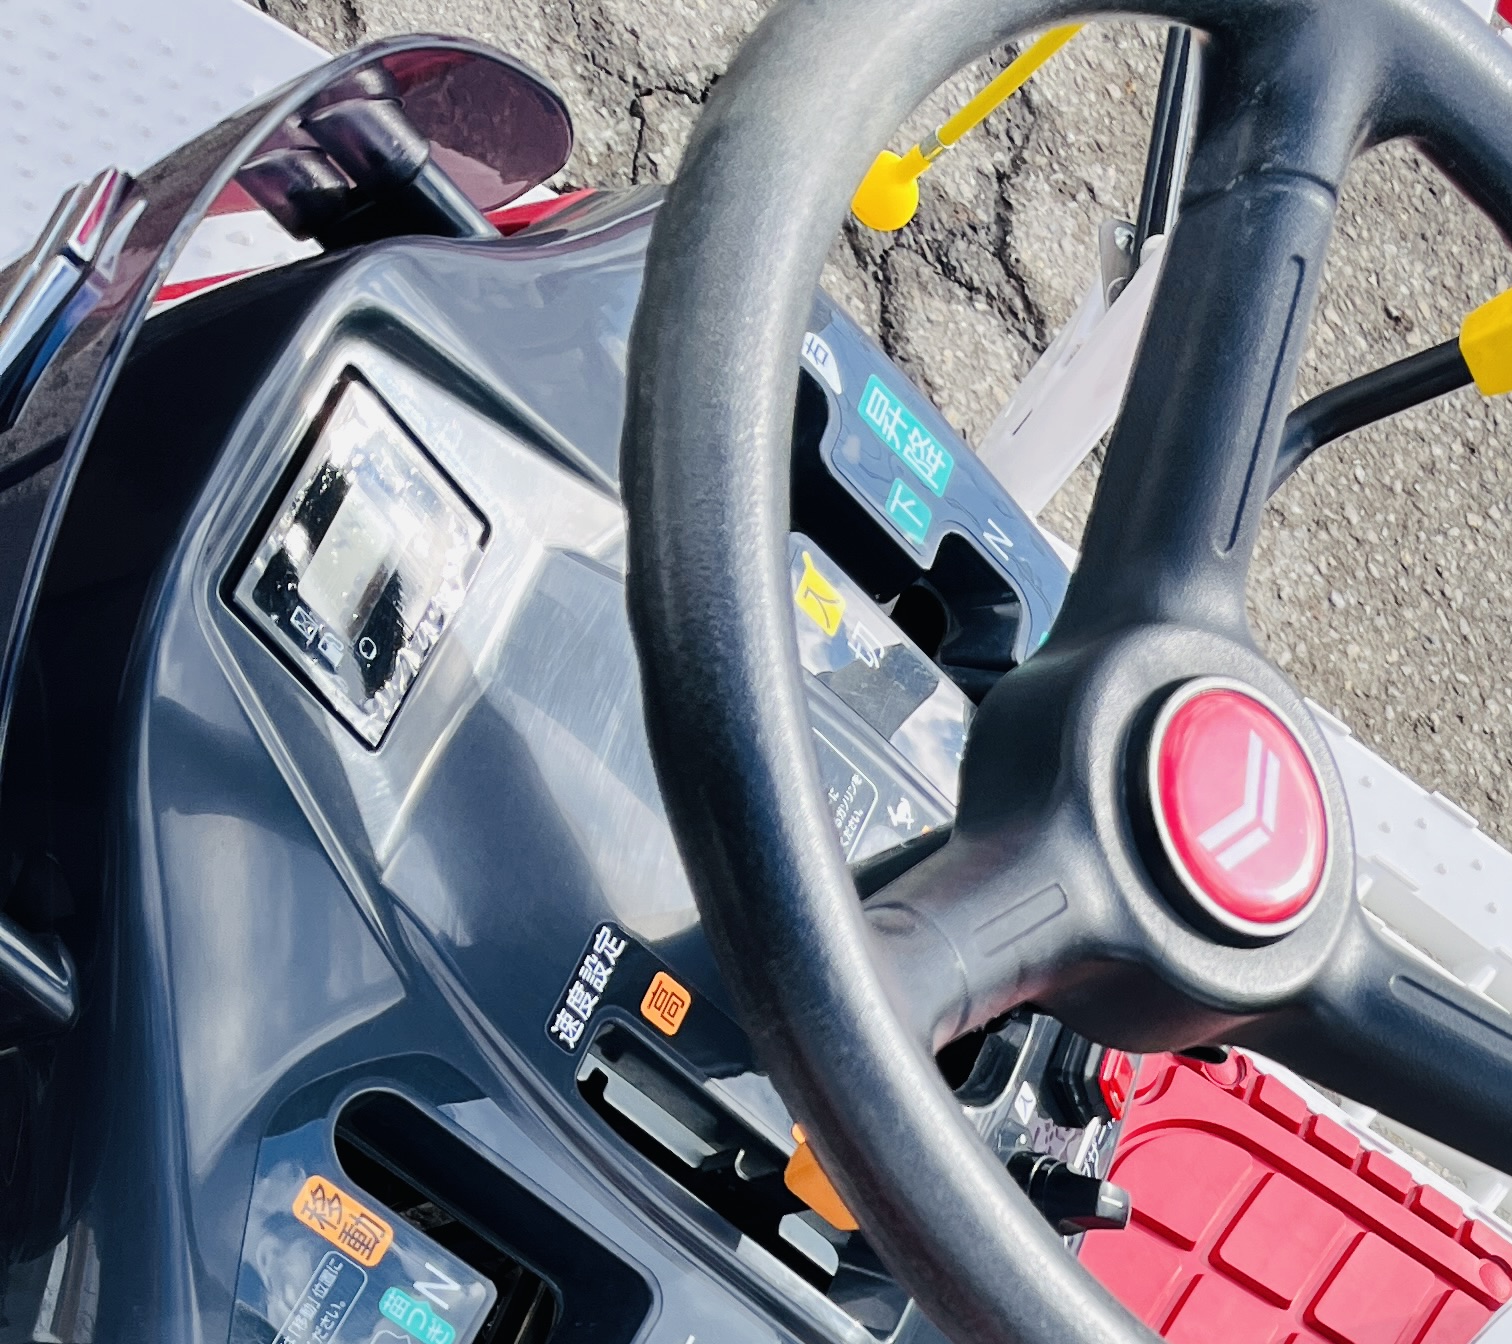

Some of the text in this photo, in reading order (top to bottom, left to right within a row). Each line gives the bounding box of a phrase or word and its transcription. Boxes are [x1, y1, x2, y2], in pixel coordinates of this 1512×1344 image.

[805, 335, 829, 367] 右
[866, 387, 946, 490] 昇降
[890, 484, 924, 528] 下
[982, 518, 1014, 561] N
[803, 585, 841, 629] 入
[847, 621, 885, 670] 切
[549, 925, 627, 1050] 速度設定
[648, 979, 686, 1028] 高
[300, 1183, 386, 1261] 移動
[412, 1261, 462, 1310] N
